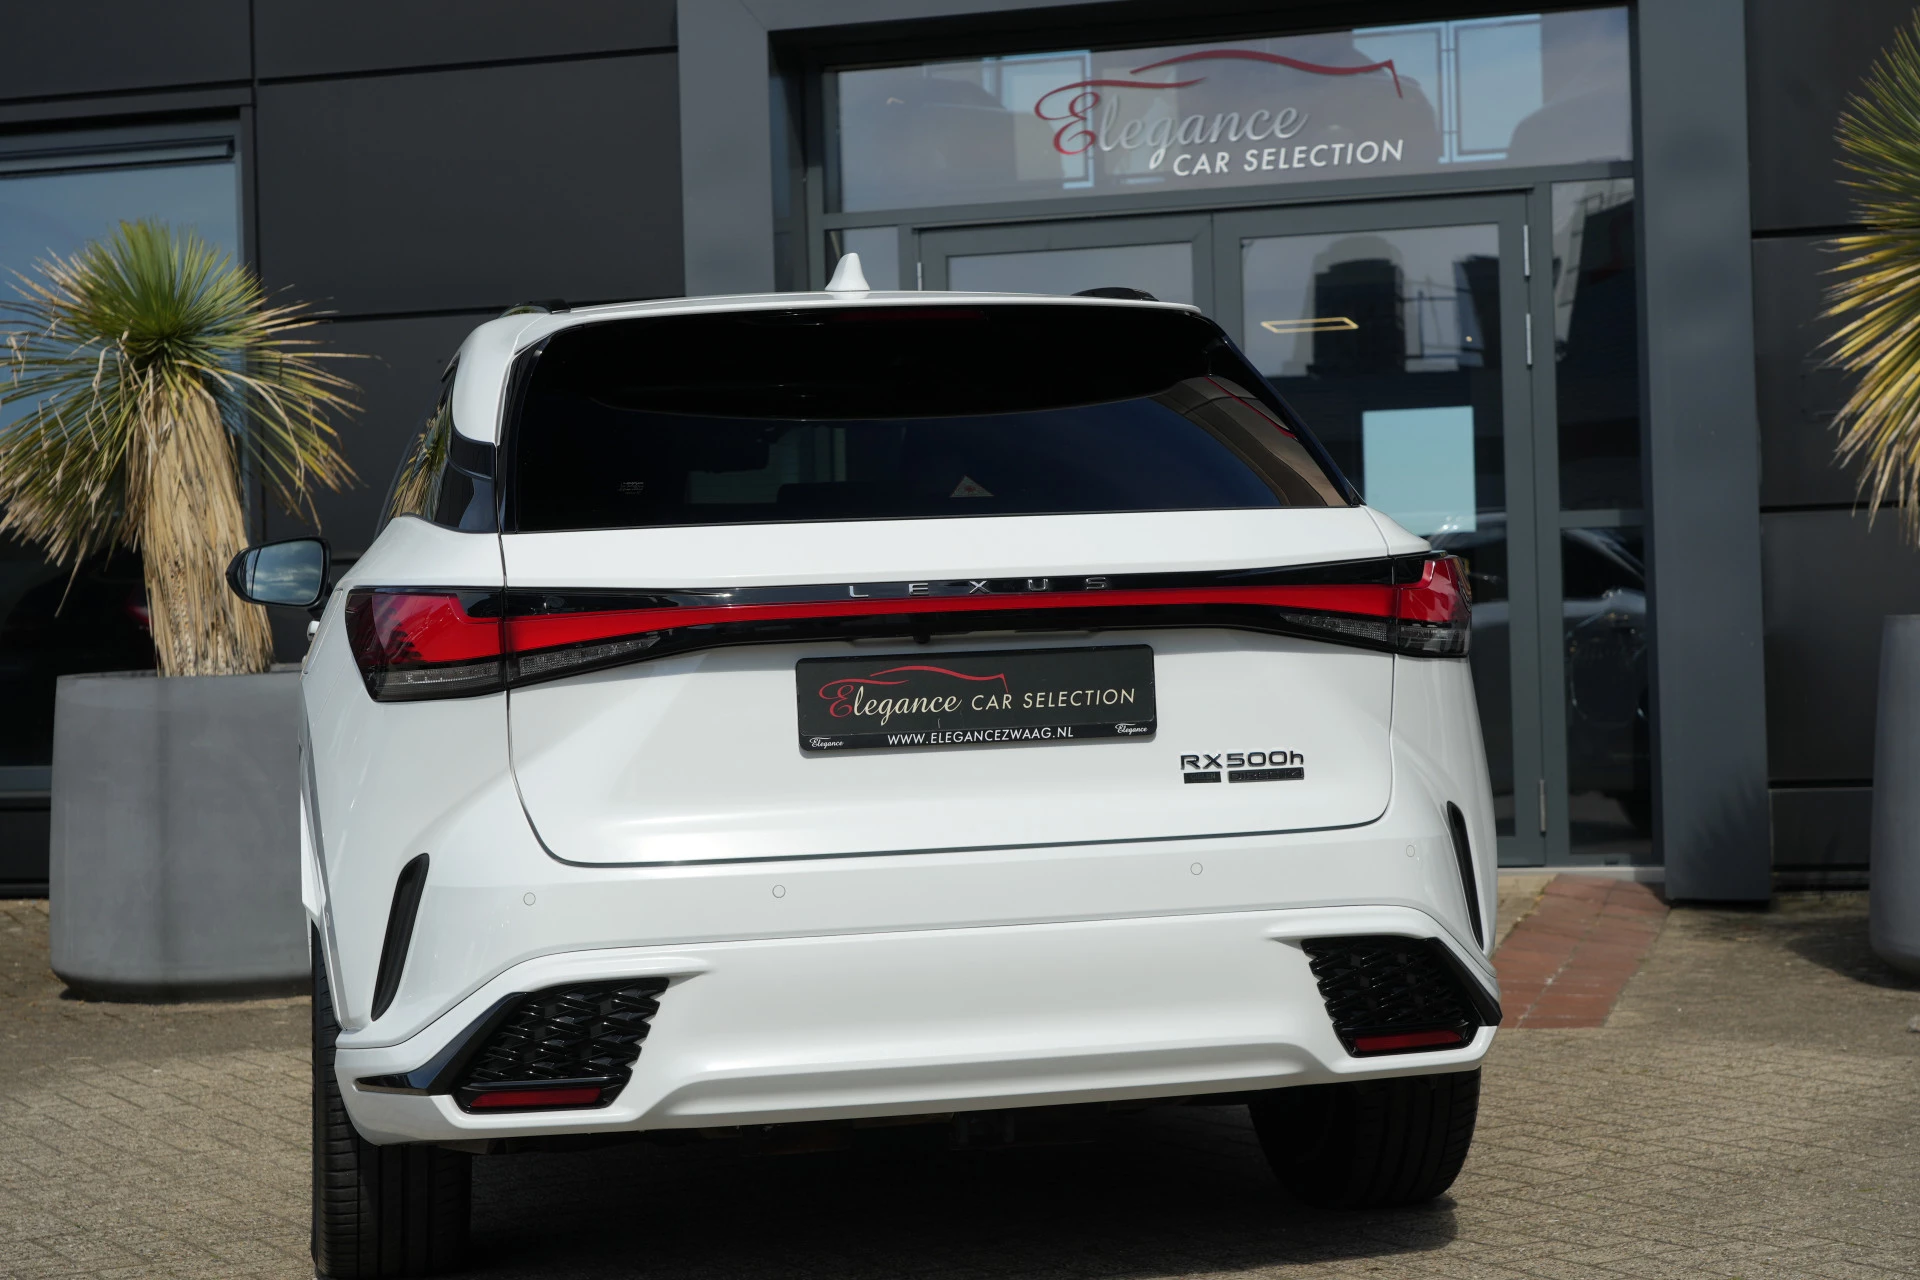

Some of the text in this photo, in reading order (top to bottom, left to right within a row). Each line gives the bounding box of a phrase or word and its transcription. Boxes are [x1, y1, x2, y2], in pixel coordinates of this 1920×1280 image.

[1035, 78, 1308, 169] Elegance
[1173, 139, 1404, 176] CAR SELECTION
[849, 577, 1106, 598] LEXUS
[819, 678, 1135, 726] Elegance CAR SELECTION
[887, 726, 1074, 745] WWW.ELEGANCEZWAAG.NL
[1115, 723, 1148, 735] Elegance
[809, 736, 844, 749] Elegance
